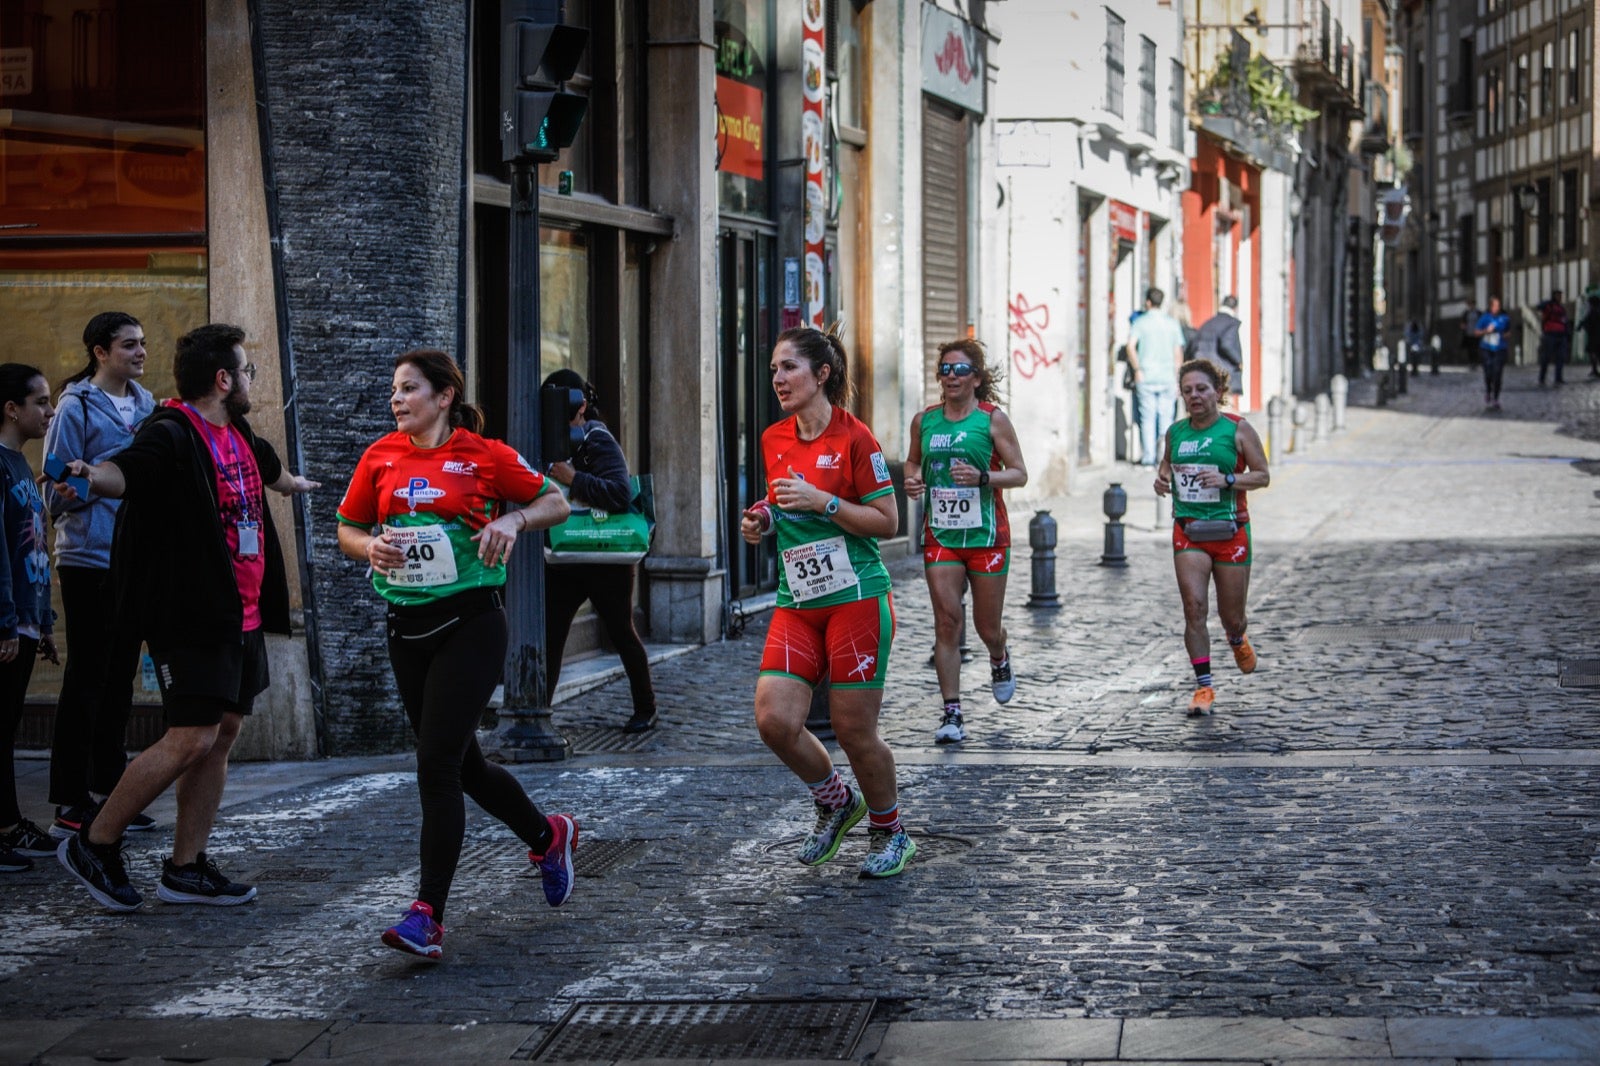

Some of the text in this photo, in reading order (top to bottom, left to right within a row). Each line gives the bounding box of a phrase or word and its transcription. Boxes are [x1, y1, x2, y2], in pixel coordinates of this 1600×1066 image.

[719, 113, 761, 151] arma King
[408, 476, 440, 497] Pancho
[1181, 474, 1203, 487] 37
[939, 499, 970, 513] 370
[394, 544, 435, 562] 40
[794, 554, 834, 579] 331
